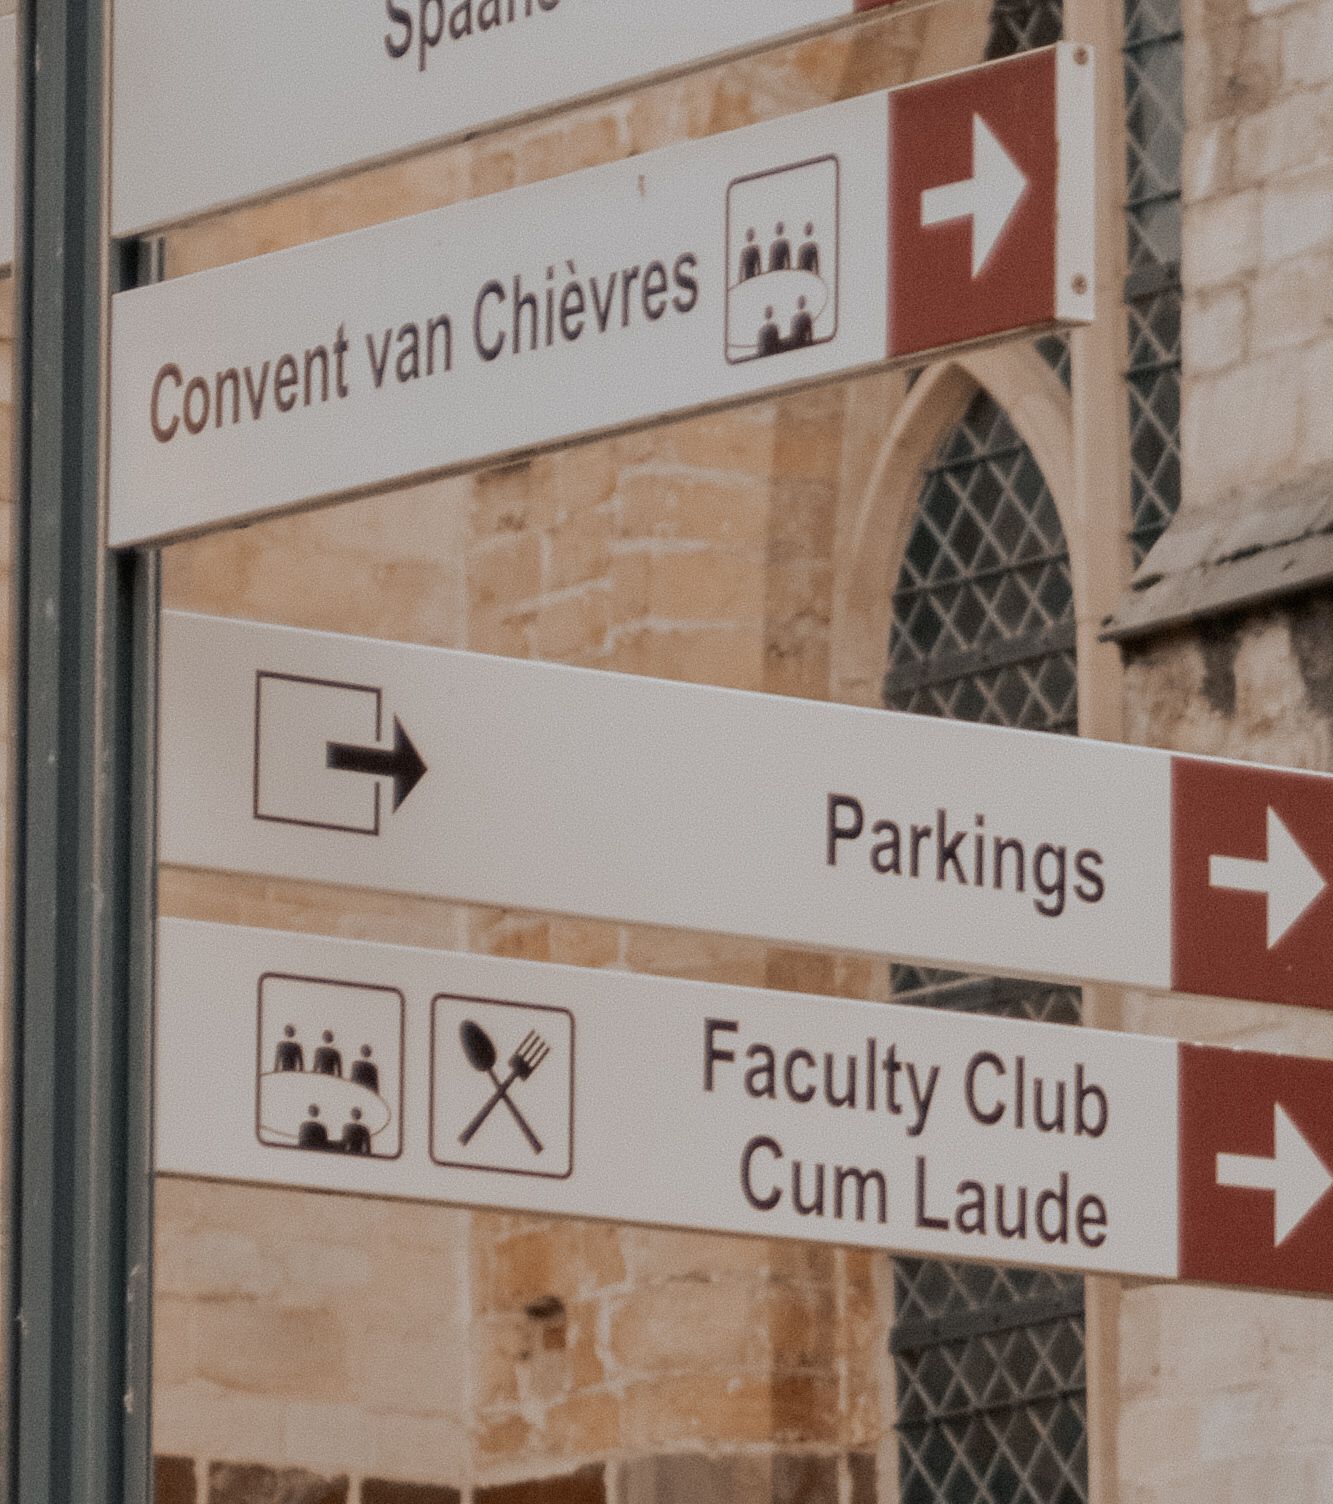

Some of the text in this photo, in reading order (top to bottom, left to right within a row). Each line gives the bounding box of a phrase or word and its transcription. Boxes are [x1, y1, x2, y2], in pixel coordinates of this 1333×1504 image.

[149, 251, 700, 445] Convent van Chièvres
[825, 791, 1107, 920] Parkings
[702, 1016, 1110, 1140] Faculty Club
[739, 1133, 1109, 1250] Cum Laude
